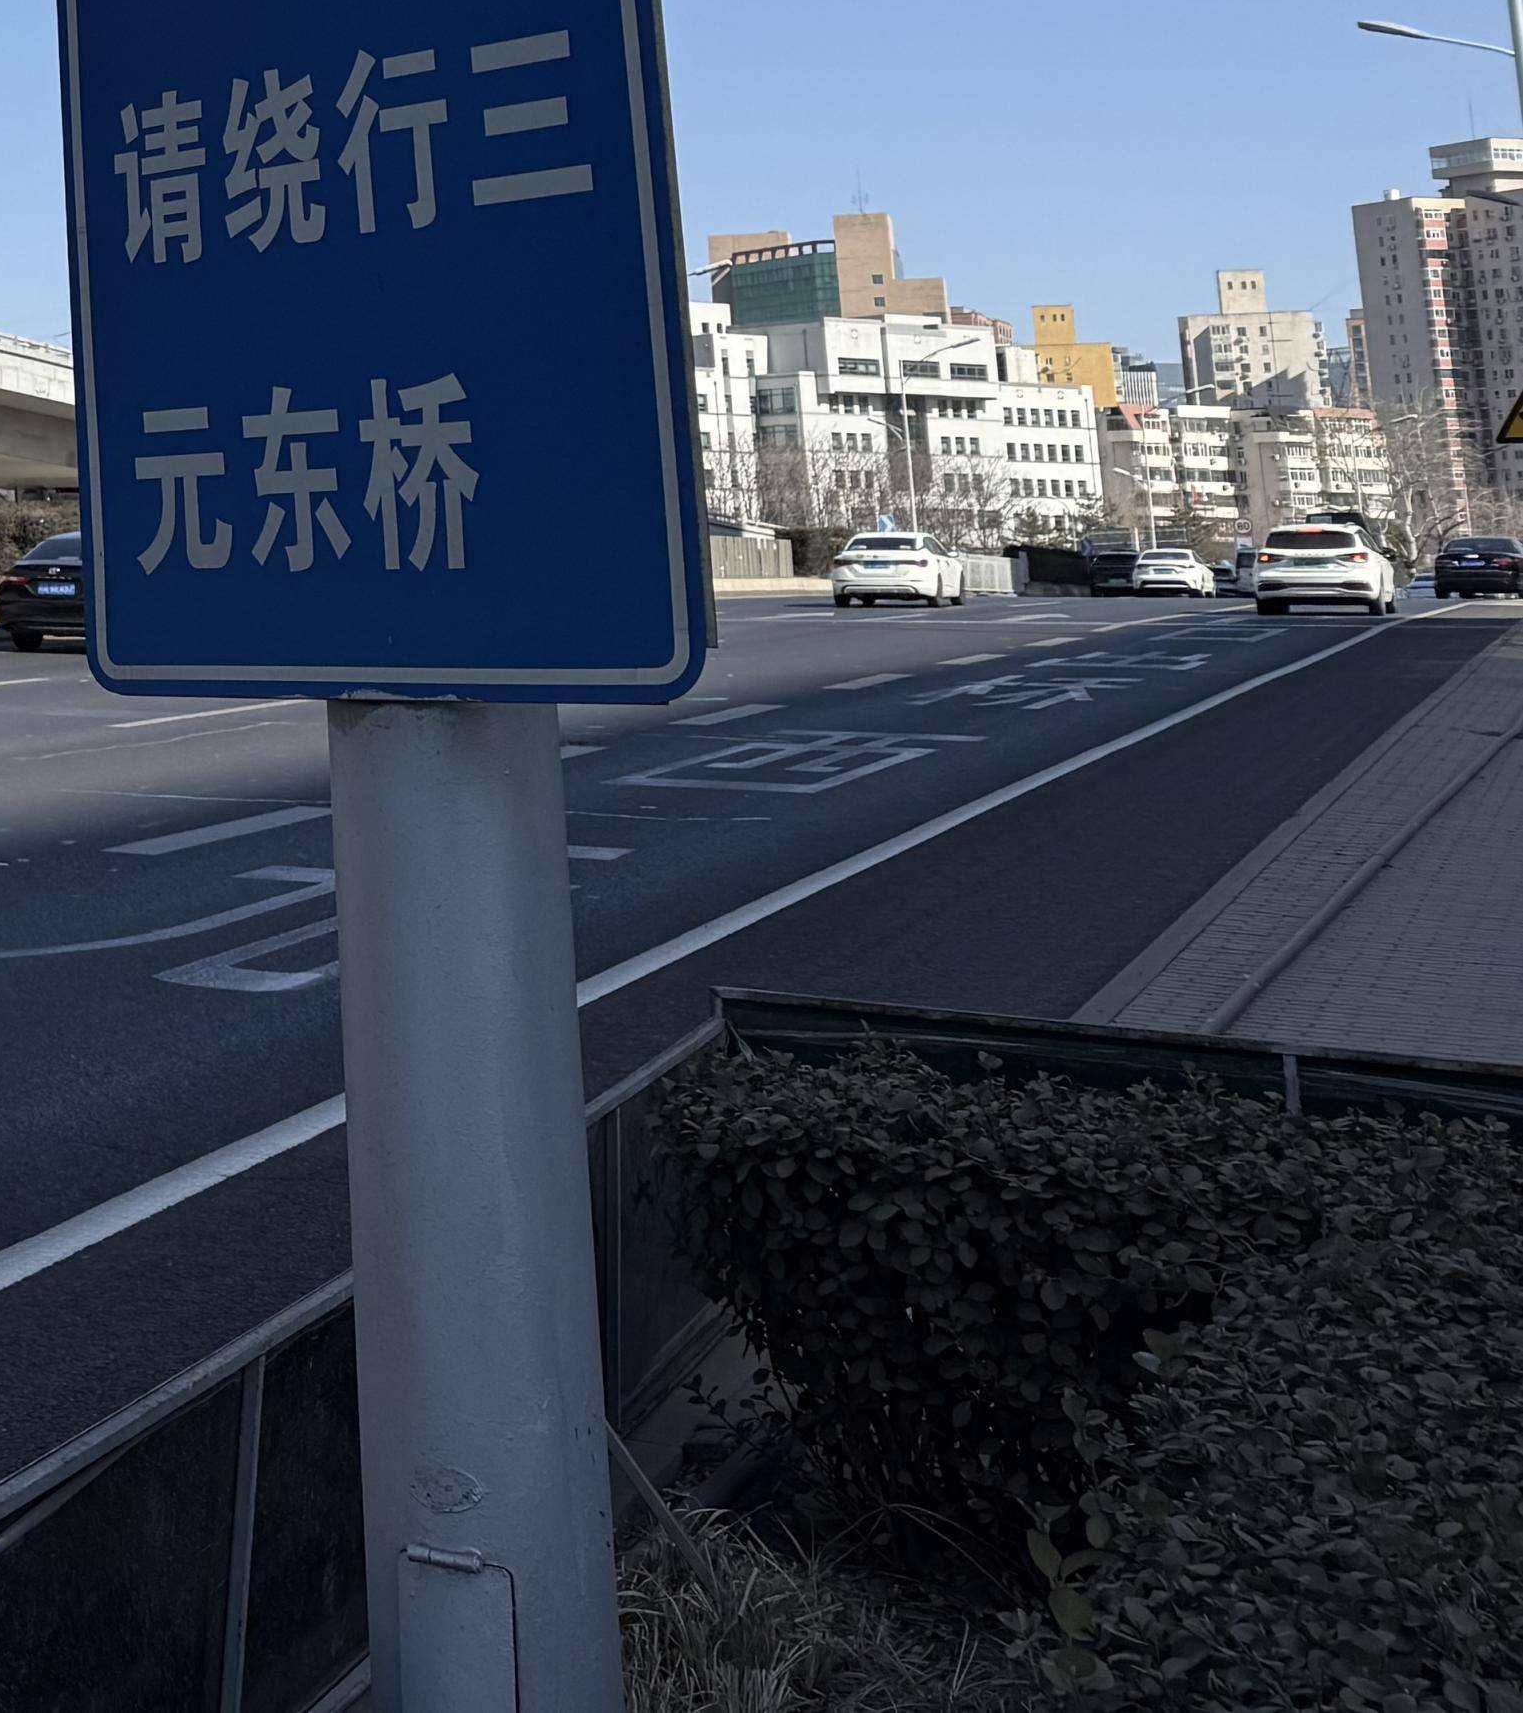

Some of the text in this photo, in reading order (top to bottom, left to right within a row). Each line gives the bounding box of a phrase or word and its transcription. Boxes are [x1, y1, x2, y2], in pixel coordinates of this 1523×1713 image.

[113, 29, 594, 264] 请绕行三
[134, 372, 480, 576] 元东桥
